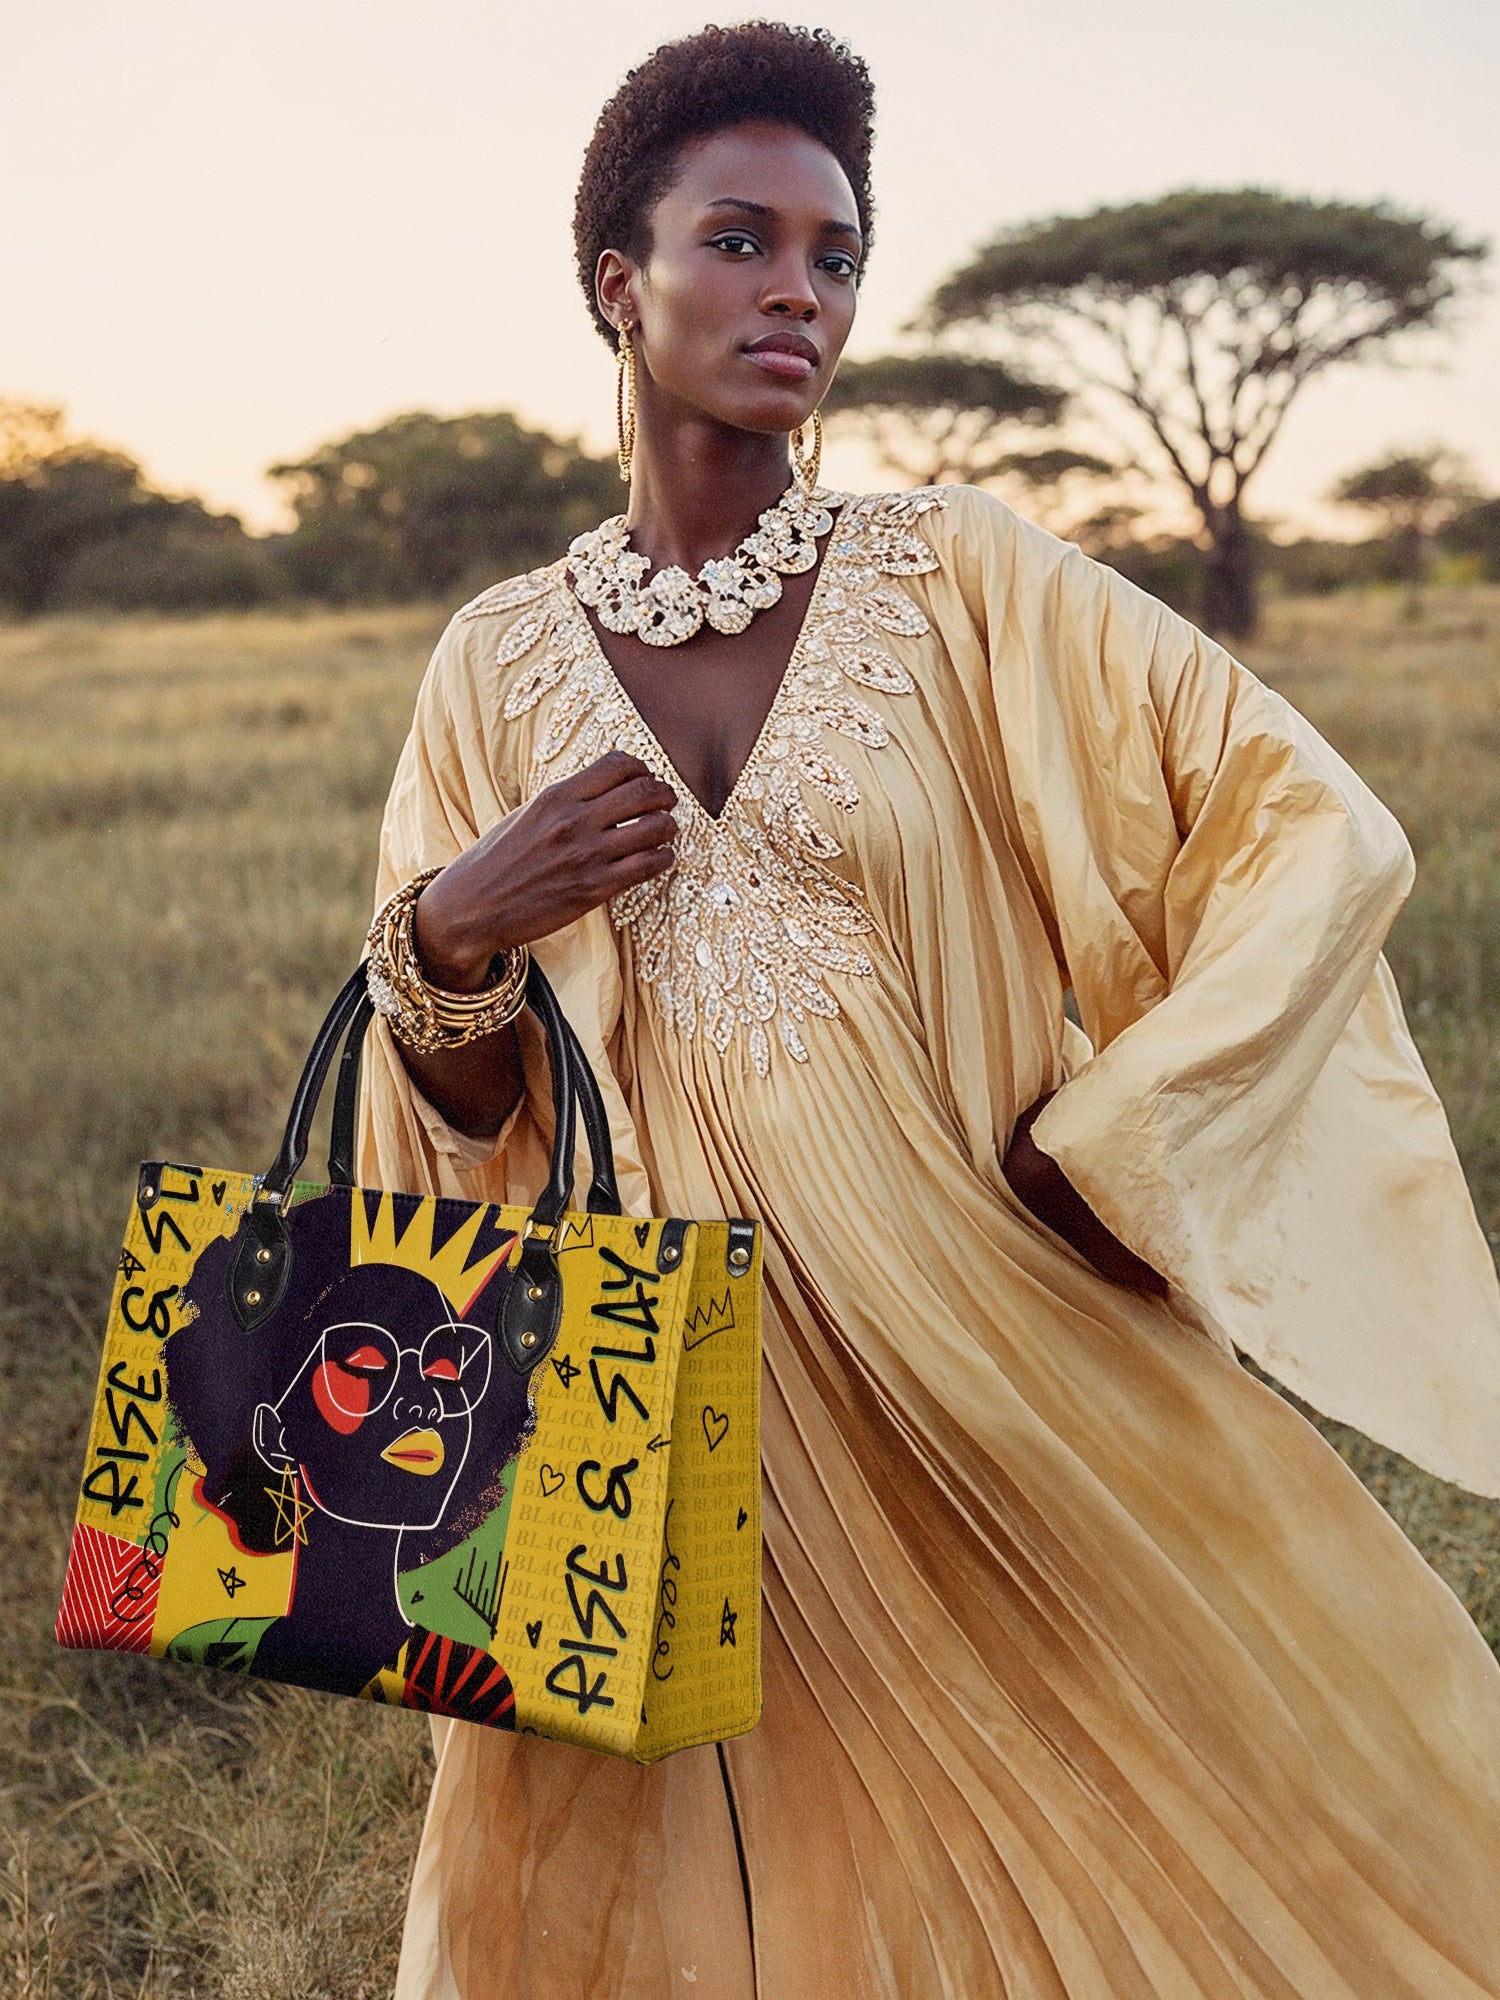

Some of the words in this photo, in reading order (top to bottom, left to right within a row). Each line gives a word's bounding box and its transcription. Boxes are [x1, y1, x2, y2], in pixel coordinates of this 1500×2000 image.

[120, 1284, 179, 1340] &
[588, 1246, 661, 1426] SLAY
[82, 1361, 163, 1518] RISE
[576, 1457, 639, 1522] &
[518, 1503, 586, 1531] BLACK
[590, 1515, 660, 1548] QUEEN
[545, 1544, 628, 1715] RISE
